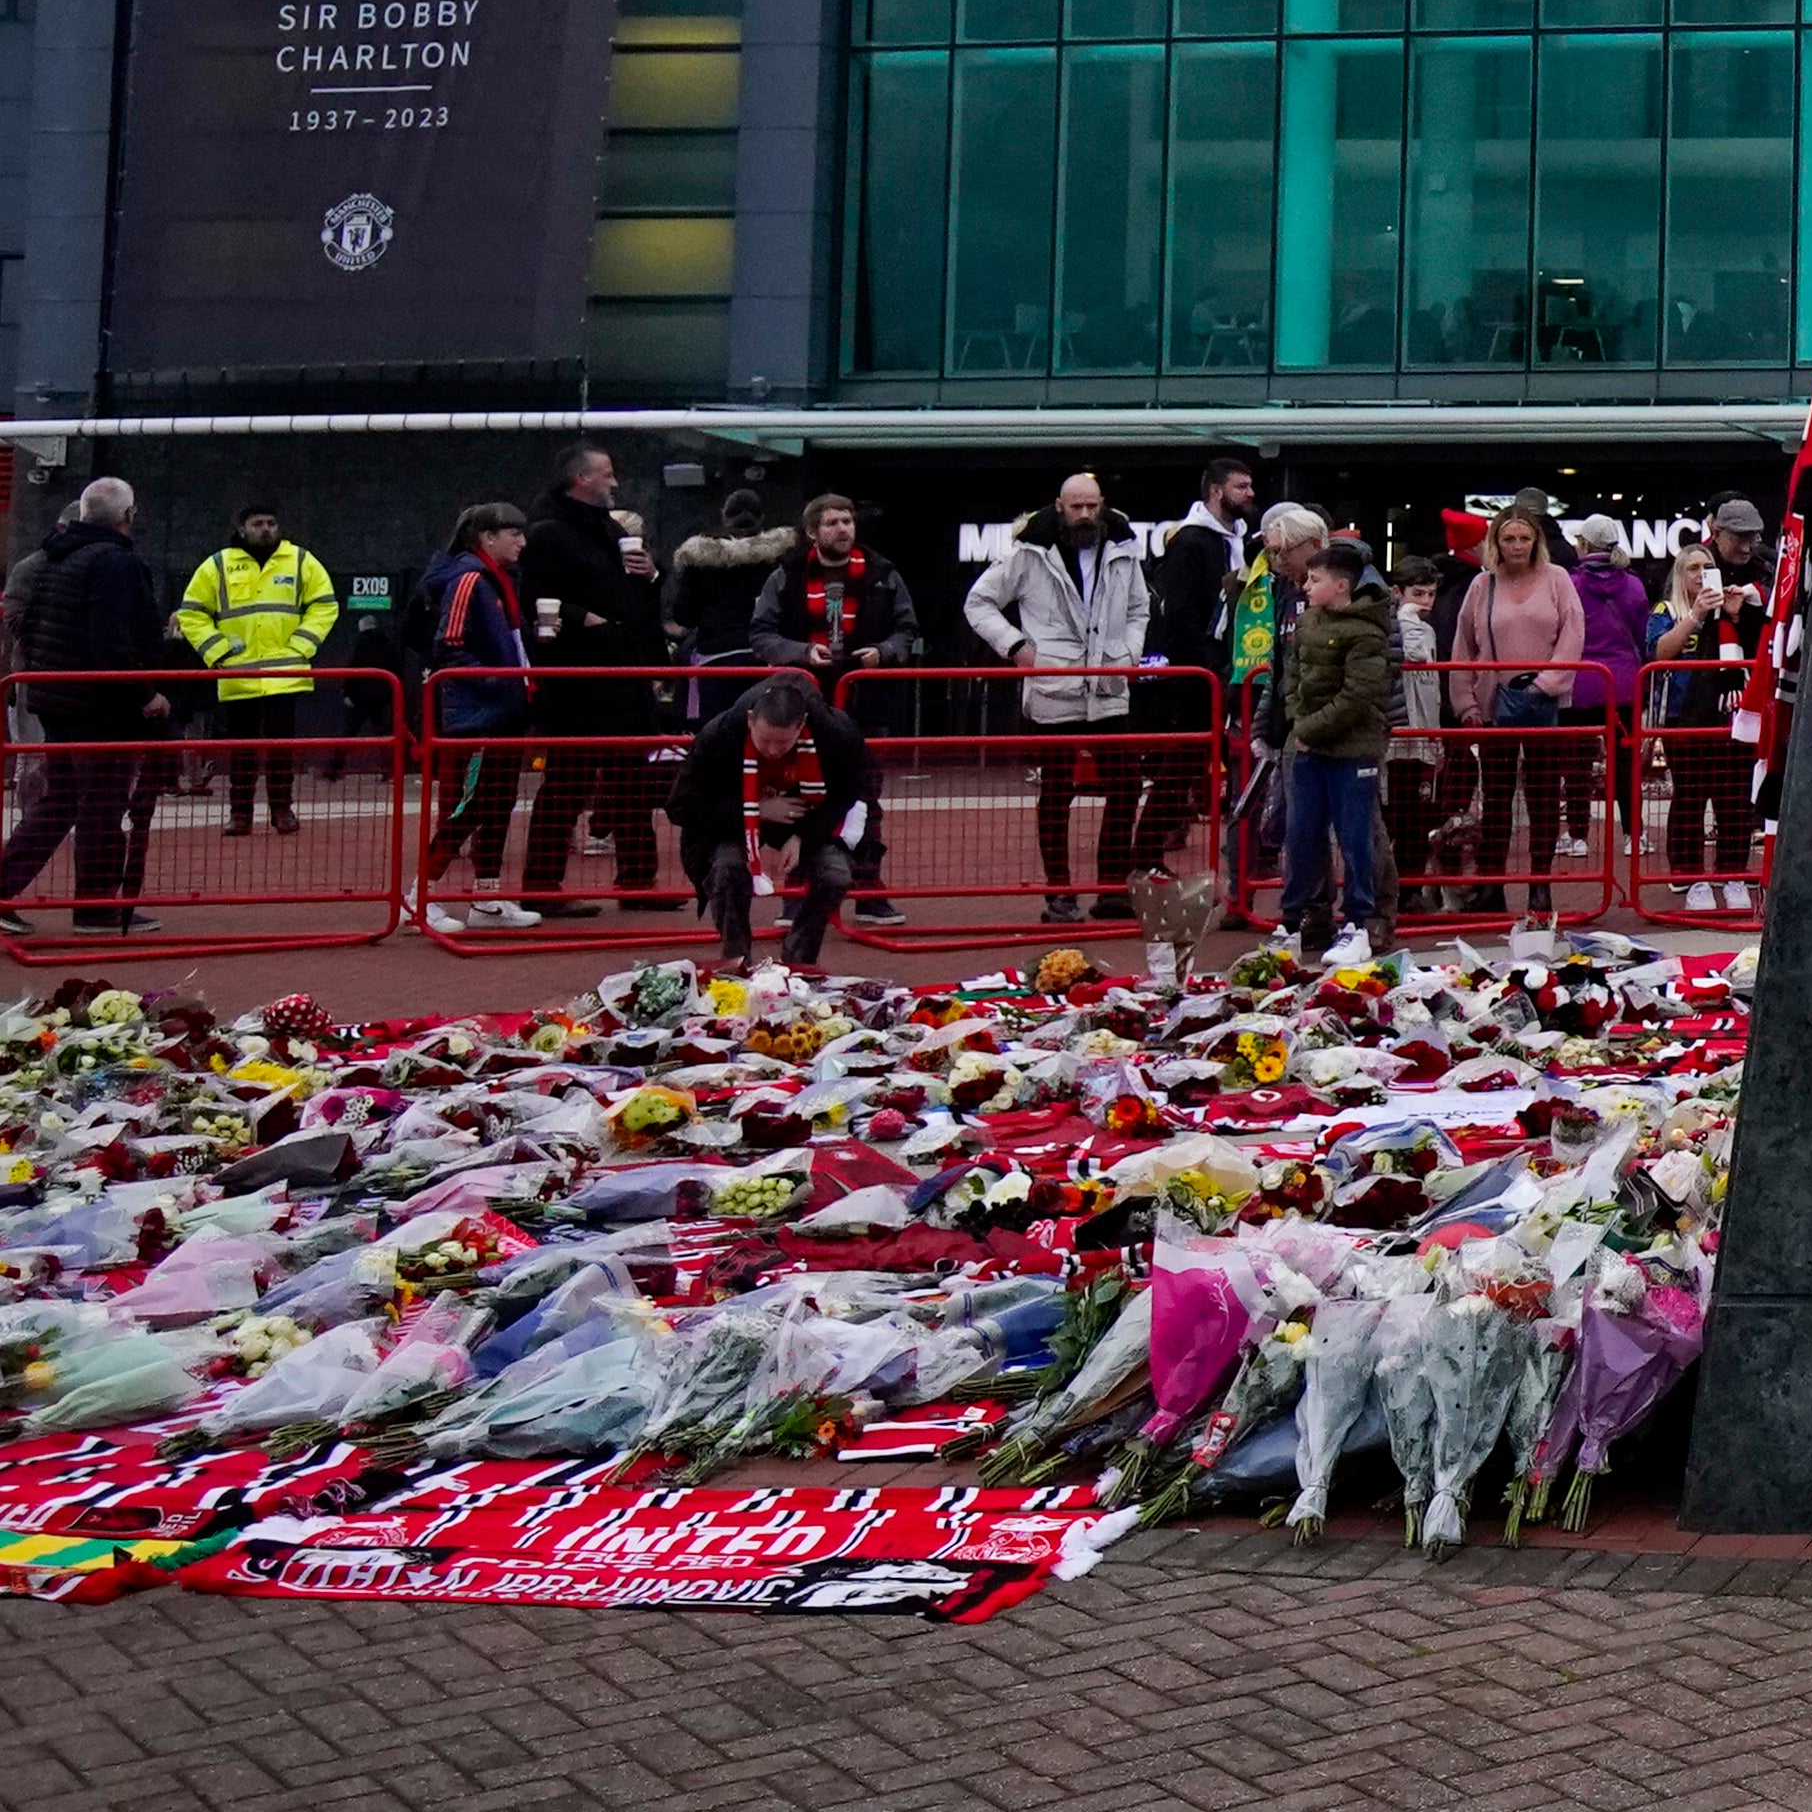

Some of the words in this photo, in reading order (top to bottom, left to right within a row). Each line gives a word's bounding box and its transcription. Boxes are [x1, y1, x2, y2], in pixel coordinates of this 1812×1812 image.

[278, 4, 338, 31] SIR
[357, 0, 479, 29] BOBBY
[276, 40, 471, 72] CHARLTON
[352, 576, 390, 595] EX09
[554, 1525, 826, 1556] UNITED
[552, 1550, 659, 1566] TRUE
[669, 1554, 755, 1568] RED
